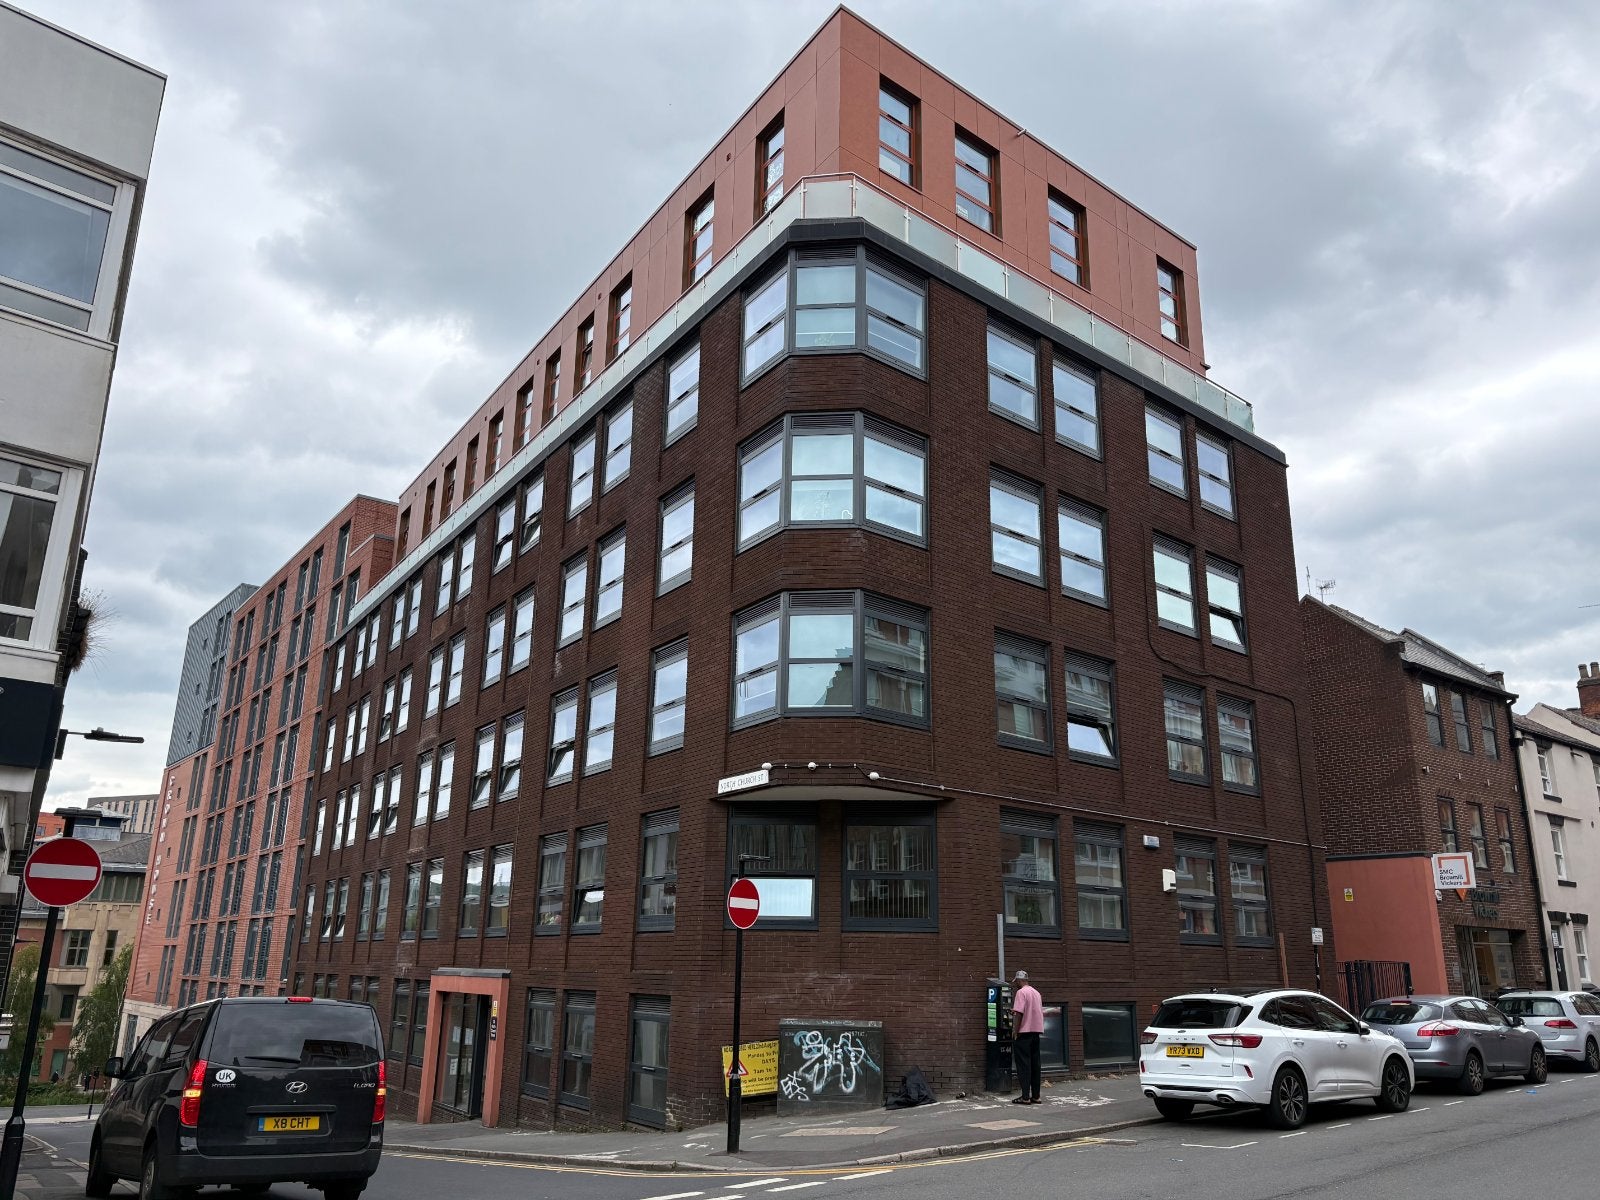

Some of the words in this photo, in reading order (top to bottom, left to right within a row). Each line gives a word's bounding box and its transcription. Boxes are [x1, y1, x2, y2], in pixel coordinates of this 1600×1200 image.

[737, 775, 757, 787] CHURCH
[988, 988, 995, 1000] P
[218, 1072, 233, 1081] UK
[273, 1118, 288, 1129] X8
[290, 1117, 312, 1128] CHT
